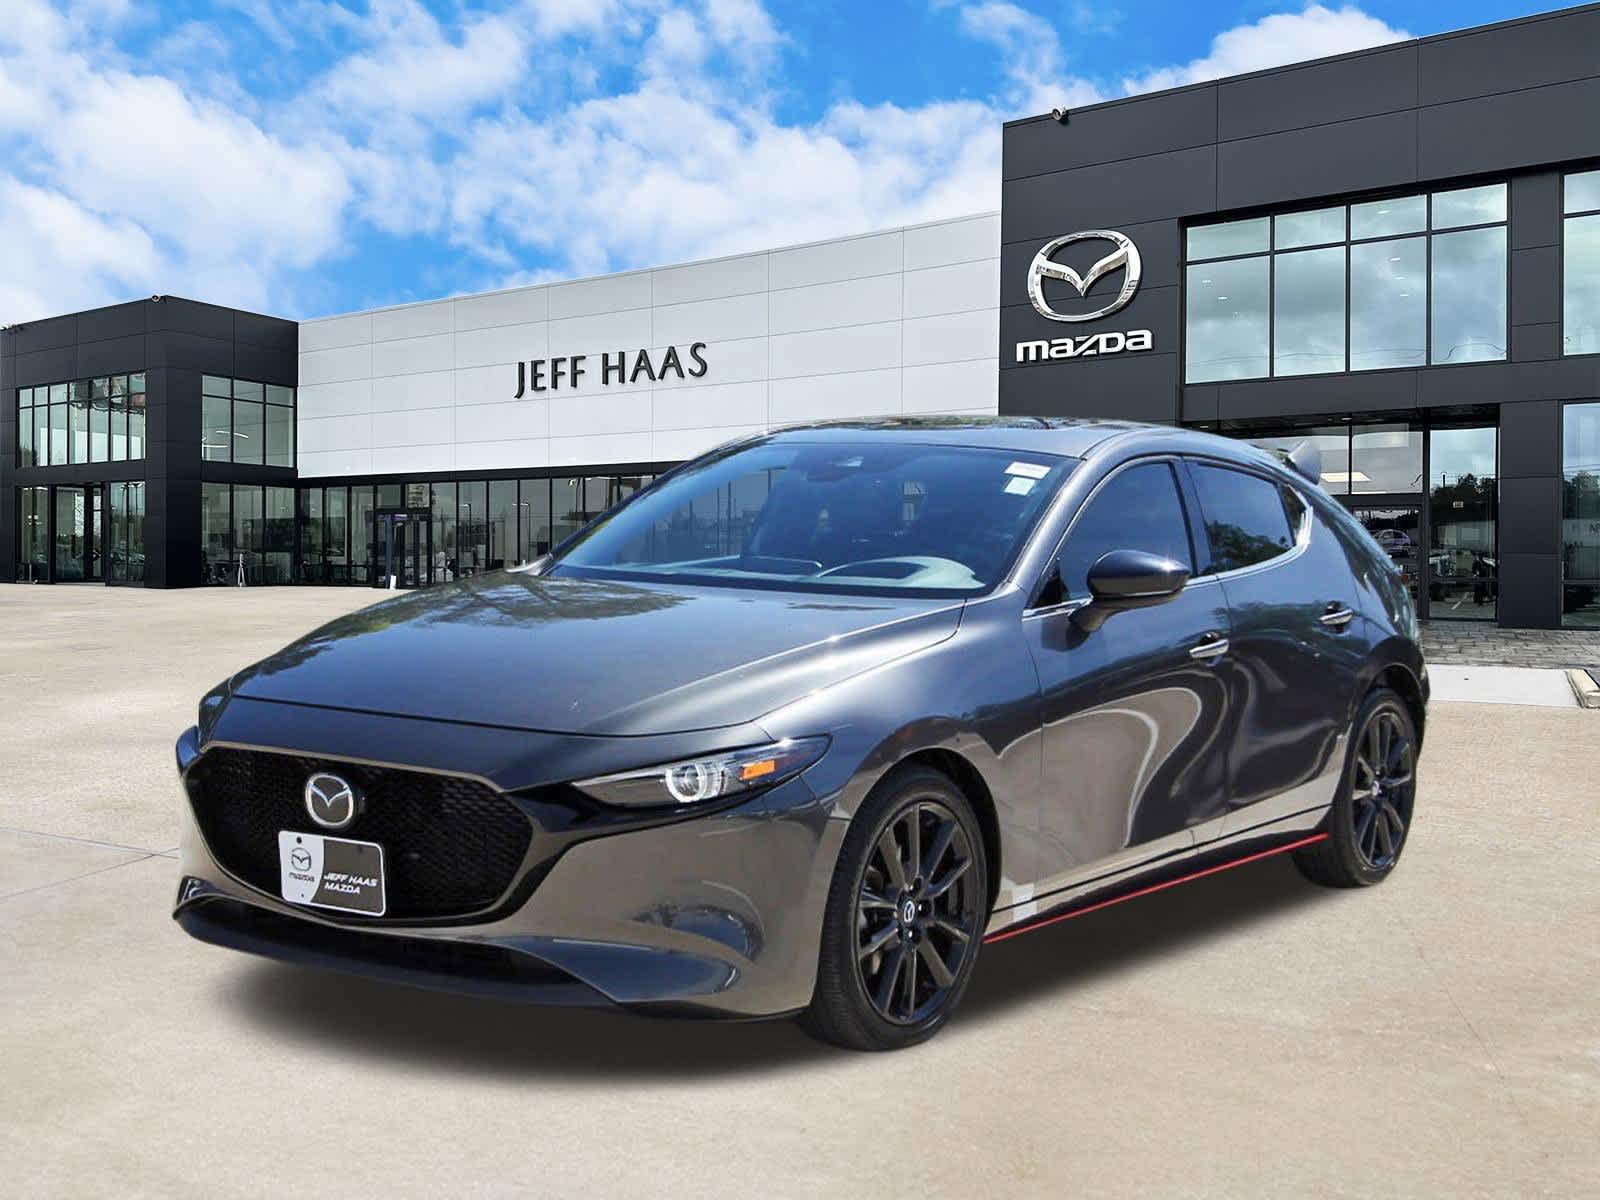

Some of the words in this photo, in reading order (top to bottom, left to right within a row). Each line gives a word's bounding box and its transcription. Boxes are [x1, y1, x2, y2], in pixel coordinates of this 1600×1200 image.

[514, 356, 586, 399] JEFF
[602, 342, 708, 386] HAAS
[323, 872, 349, 882] JEFF
[348, 874, 378, 887] HAAS
[324, 882, 361, 894] MAZDA
